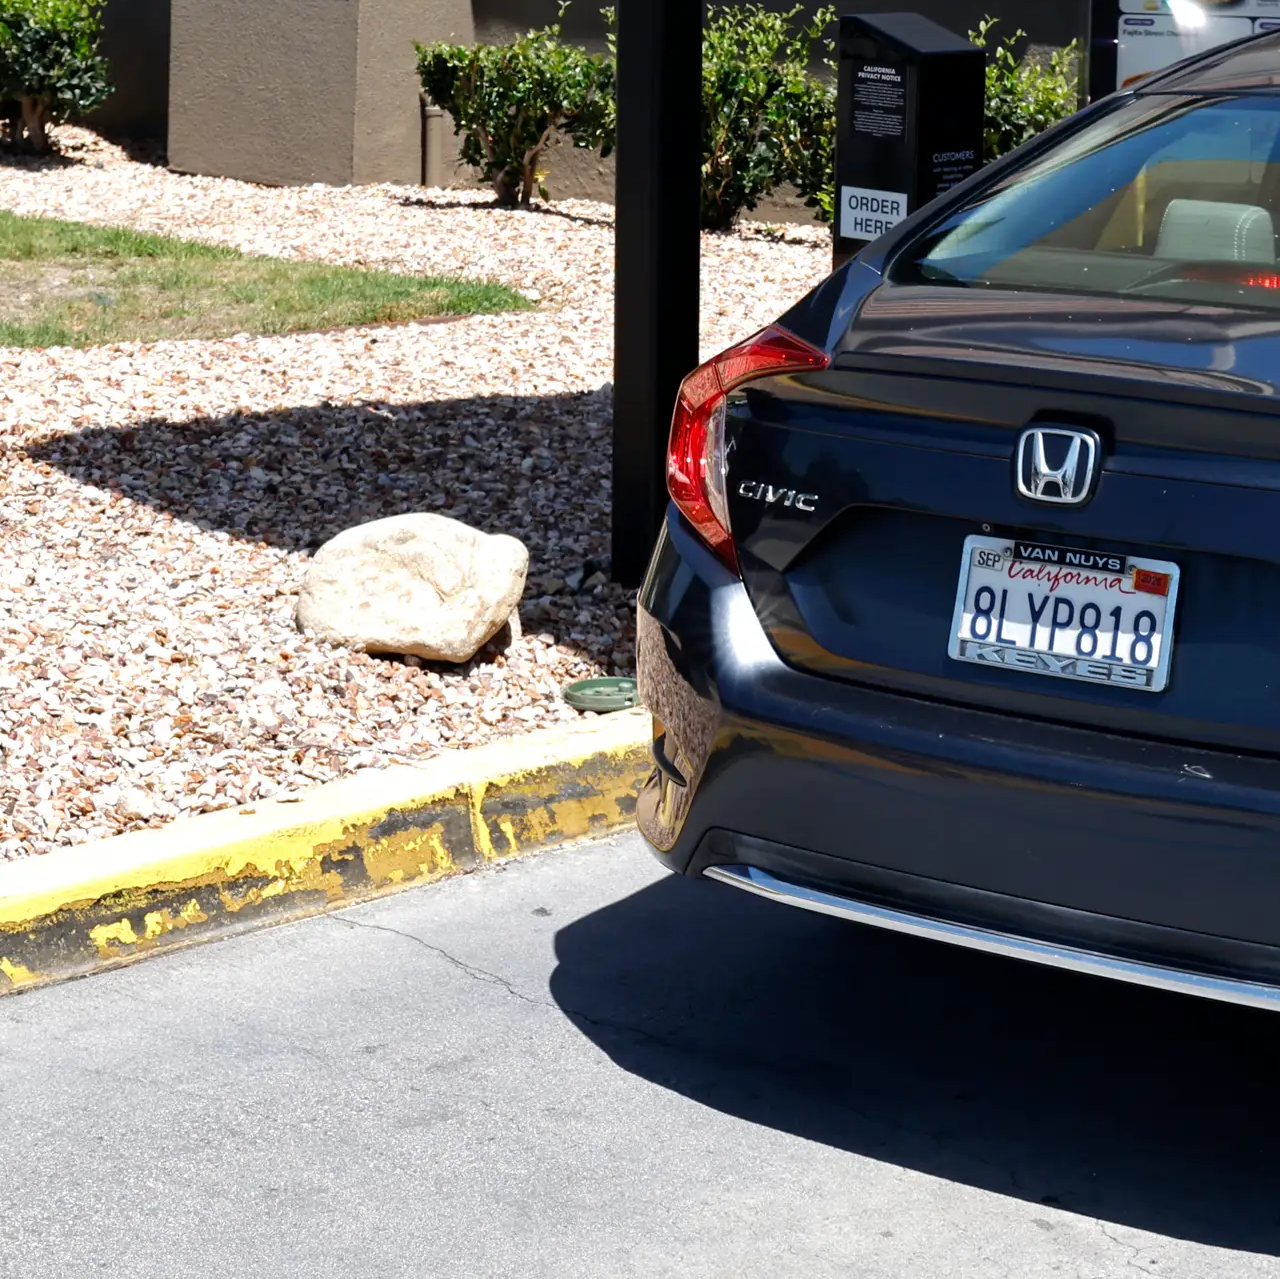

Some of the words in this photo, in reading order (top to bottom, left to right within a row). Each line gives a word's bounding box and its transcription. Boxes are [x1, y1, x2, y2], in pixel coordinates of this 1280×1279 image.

[858, 71, 880, 80] PRIVACY
[881, 74, 901, 82] NOTICE
[863, 65, 896, 75] CALIFORNIA
[932, 150, 975, 163] CUSTOMERS
[848, 195, 900, 216] ORDER
[737, 480, 819, 512] CIVIC
[977, 551, 1001, 568] SEP
[1019, 546, 1059, 562] VAN
[1065, 551, 1121, 570] NUYS
[1007, 559, 1137, 594] California
[969, 585, 1158, 666] 8LYP818
[965, 643, 1150, 687] KEYES
